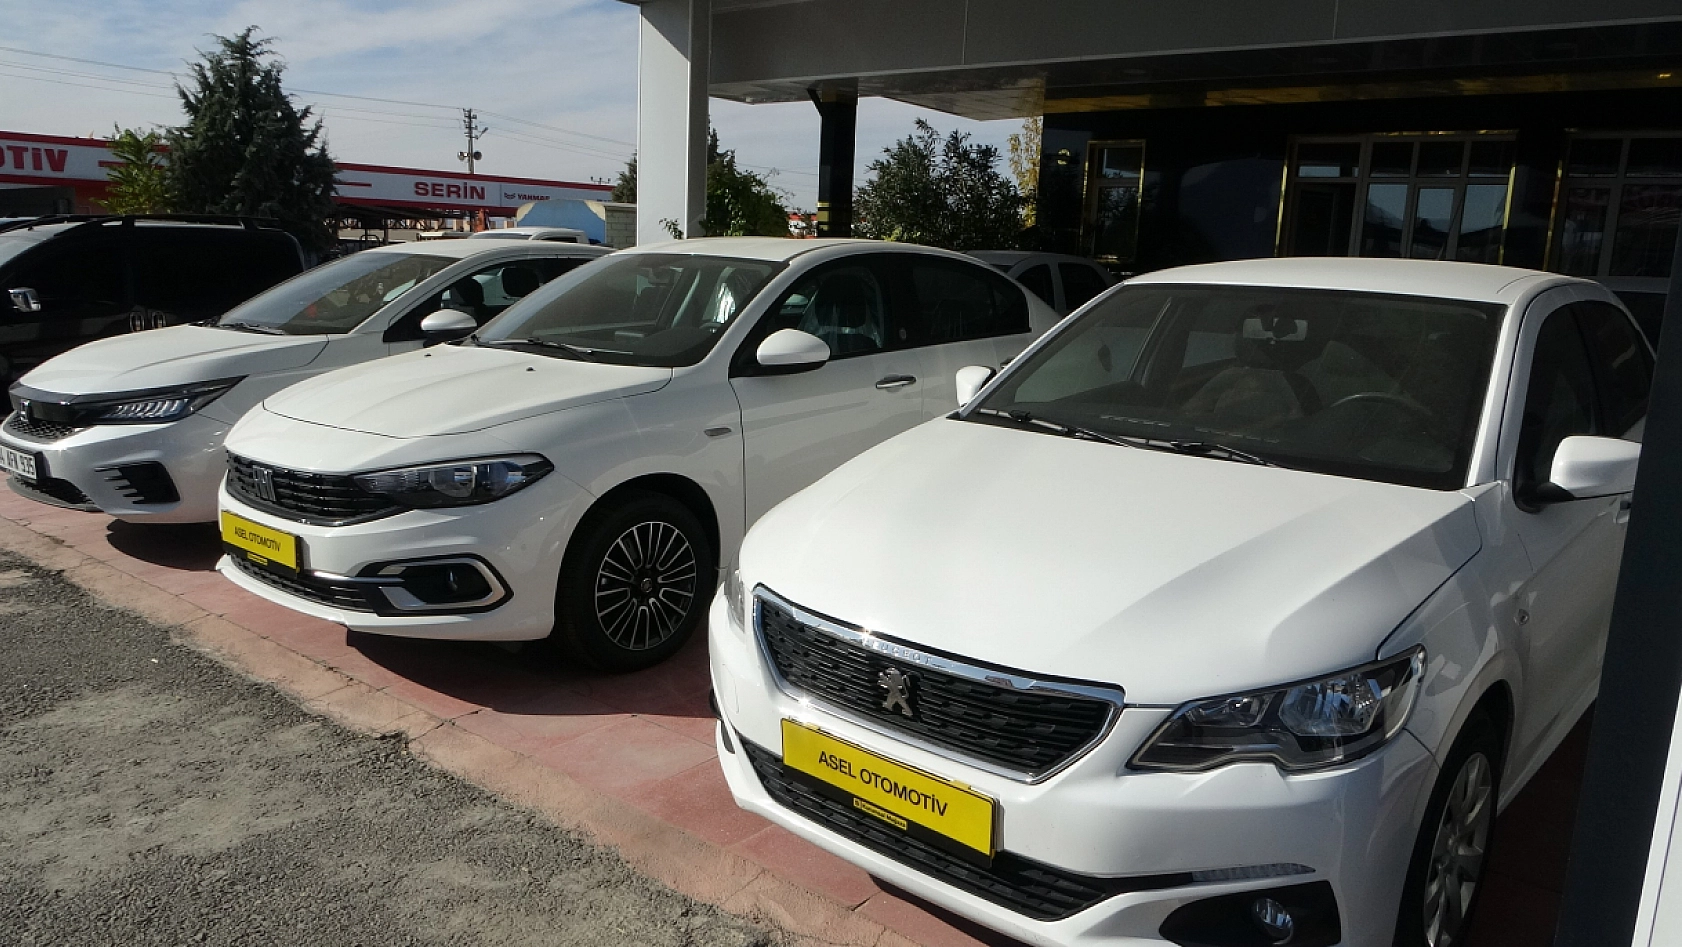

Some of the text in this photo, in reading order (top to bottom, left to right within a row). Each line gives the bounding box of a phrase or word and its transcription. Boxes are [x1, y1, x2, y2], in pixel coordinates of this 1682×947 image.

[414, 181, 486, 200] SERİN
[818, 750, 948, 817] ASEL OTOMOTİV
